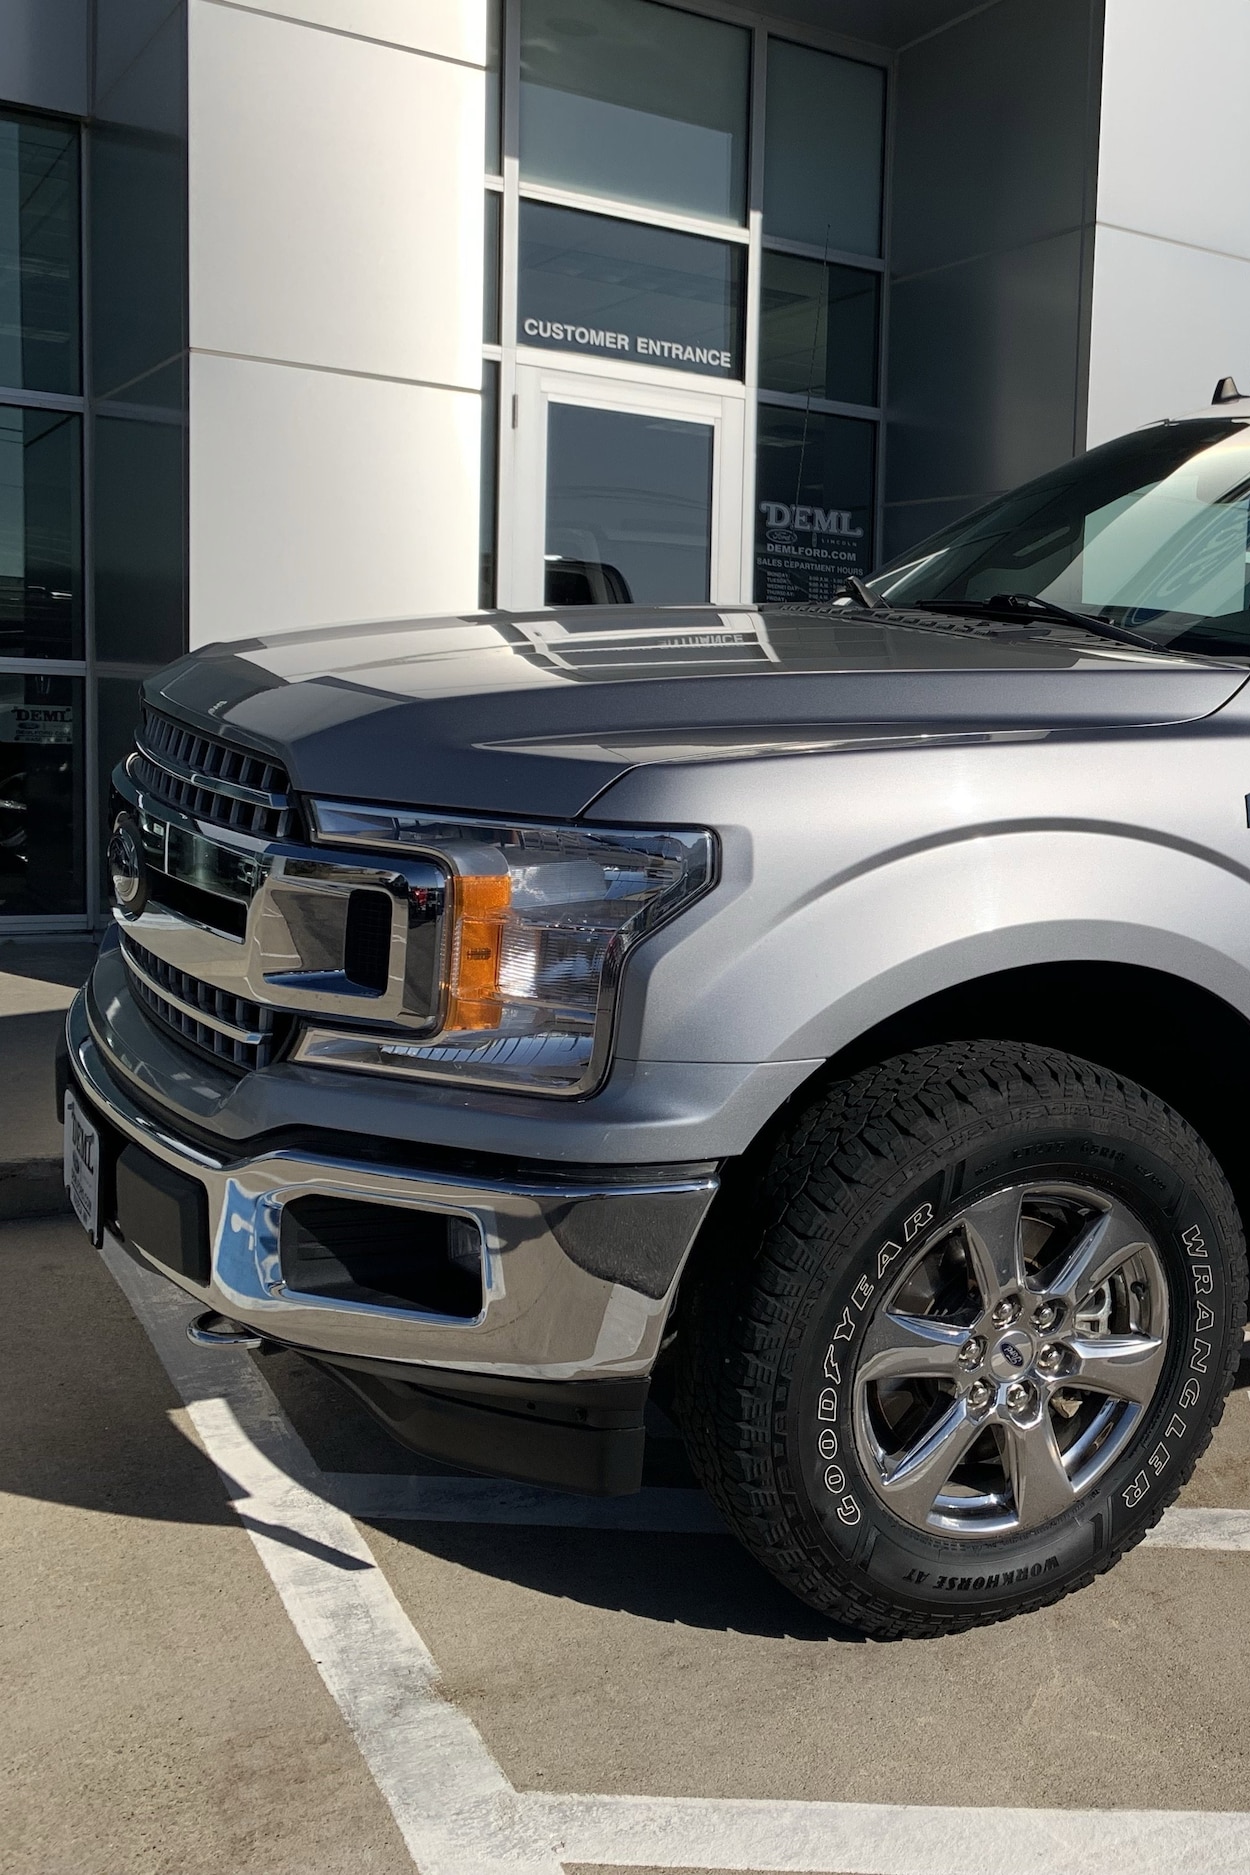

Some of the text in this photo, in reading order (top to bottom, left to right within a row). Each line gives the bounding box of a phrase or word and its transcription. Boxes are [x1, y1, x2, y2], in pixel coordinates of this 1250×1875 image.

[524, 318, 732, 368] CUSTOMER ENTRANCE
[759, 500, 865, 538] DEML
[756, 557, 864, 577] SALES DEPARTMENT HOURS
[766, 543, 858, 561] DEMLFORD.COM
[11, 706, 72, 722] DEML
[818, 1202, 934, 1526] GOODYEAR
[1122, 1224, 1215, 1509] WRANGLER
[902, 1555, 1060, 1592] WORKHORSE AT
